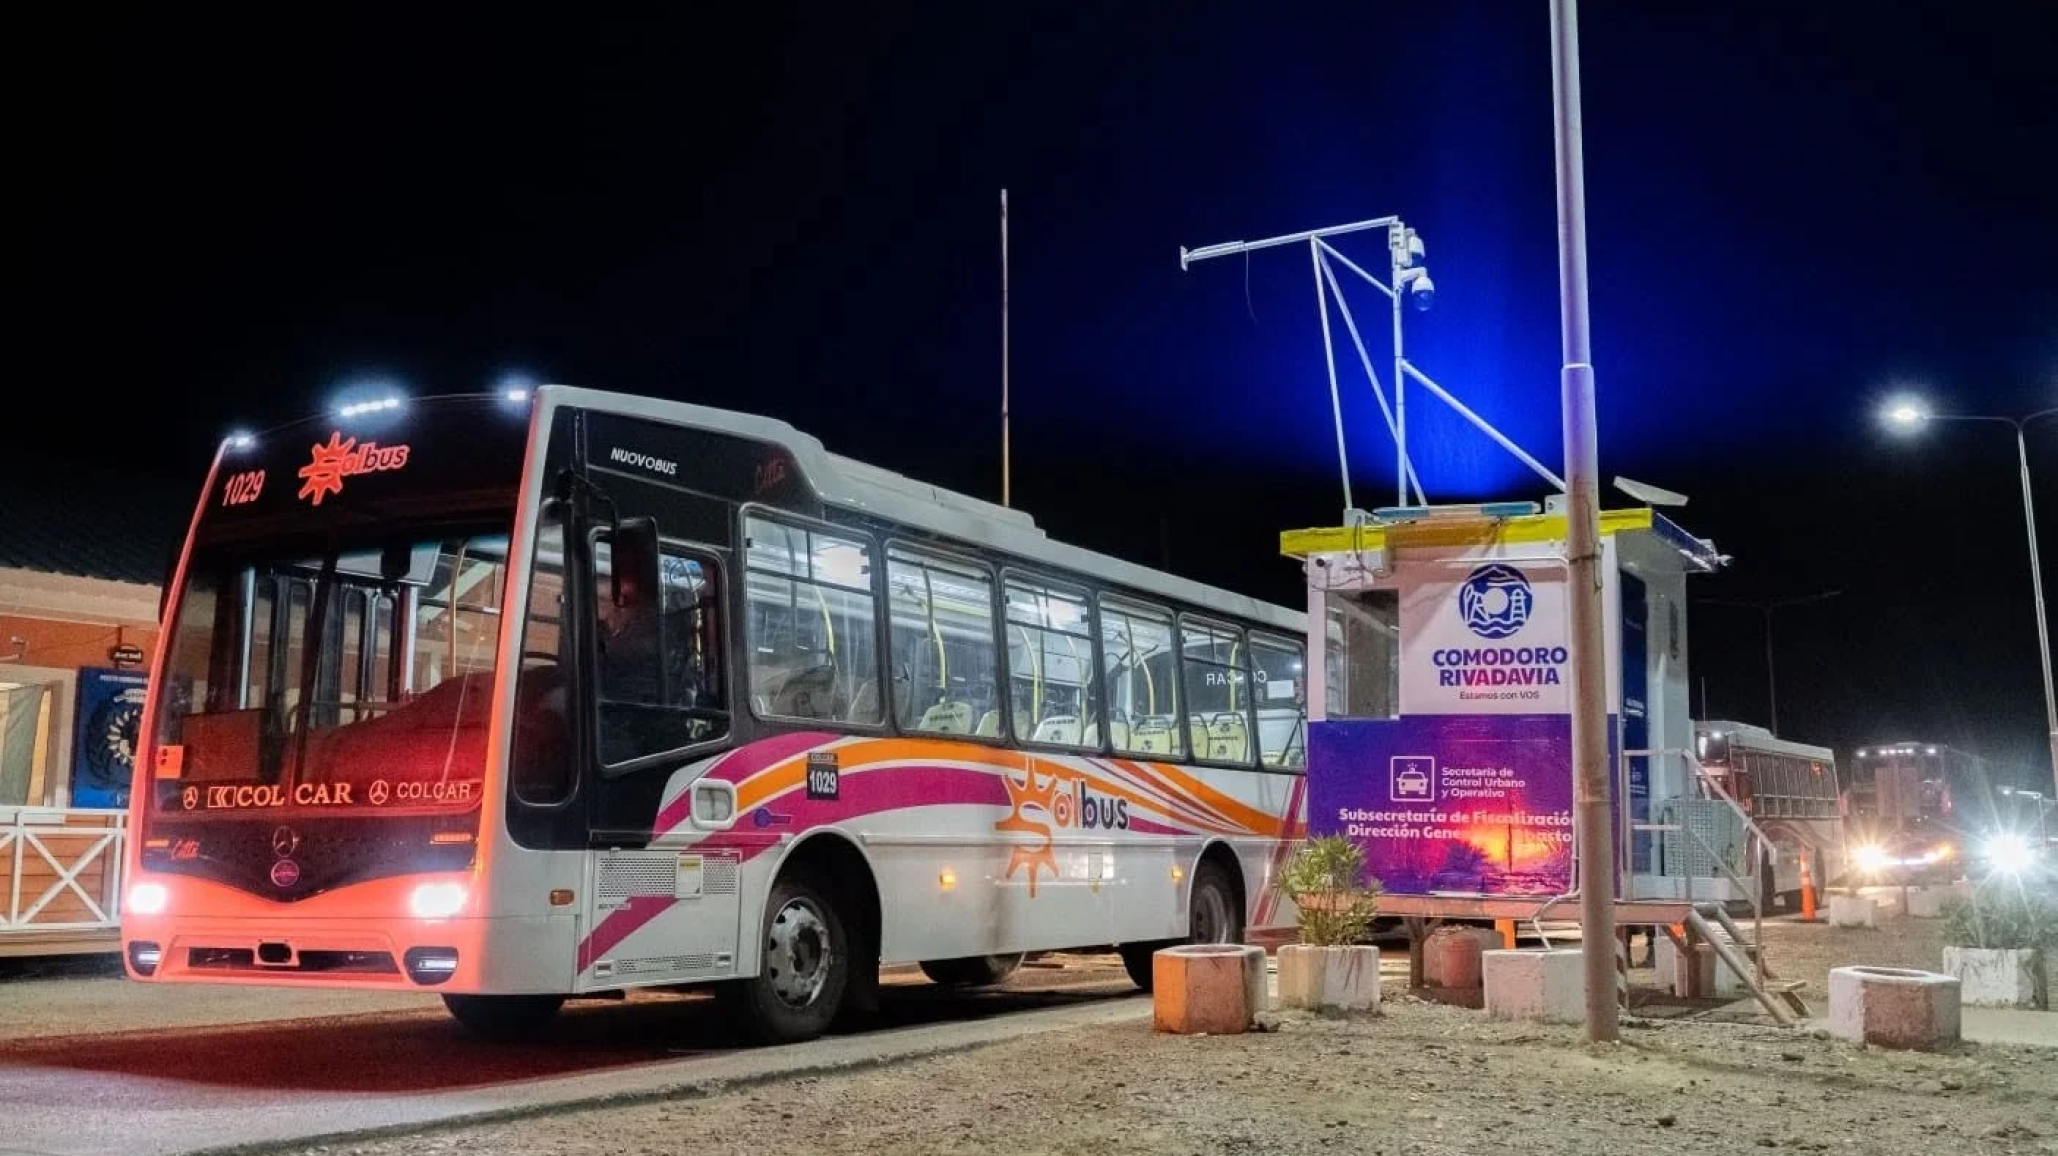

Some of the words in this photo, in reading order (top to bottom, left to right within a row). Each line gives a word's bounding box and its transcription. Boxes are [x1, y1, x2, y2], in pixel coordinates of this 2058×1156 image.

[611, 447, 677, 476] NUOVOBUS
[222, 469, 266, 507] 1029
[1433, 646, 1568, 666] COMODORO
[1439, 668, 1560, 687] RIVADAVIA
[1460, 691, 1498, 700] Estamos
[1499, 692, 1517, 700] con
[1519, 690, 1539, 699] VOS
[1499, 767, 1514, 777] de
[396, 781, 471, 799] COLCAR
[809, 770, 837, 794] 1029
[1442, 777, 1482, 787] Control
[1484, 777, 1526, 788] Urbano
[236, 785, 285, 807] COL
[295, 782, 353, 805] CAR
[1441, 789, 1449, 799] y
[1451, 788, 1505, 798] Operativo
[1339, 807, 1447, 823] Subsecretaría
[1449, 811, 1470, 823] de
[1473, 810, 1573, 826] Fiscalizació
[1348, 822, 1420, 838] Dirección
